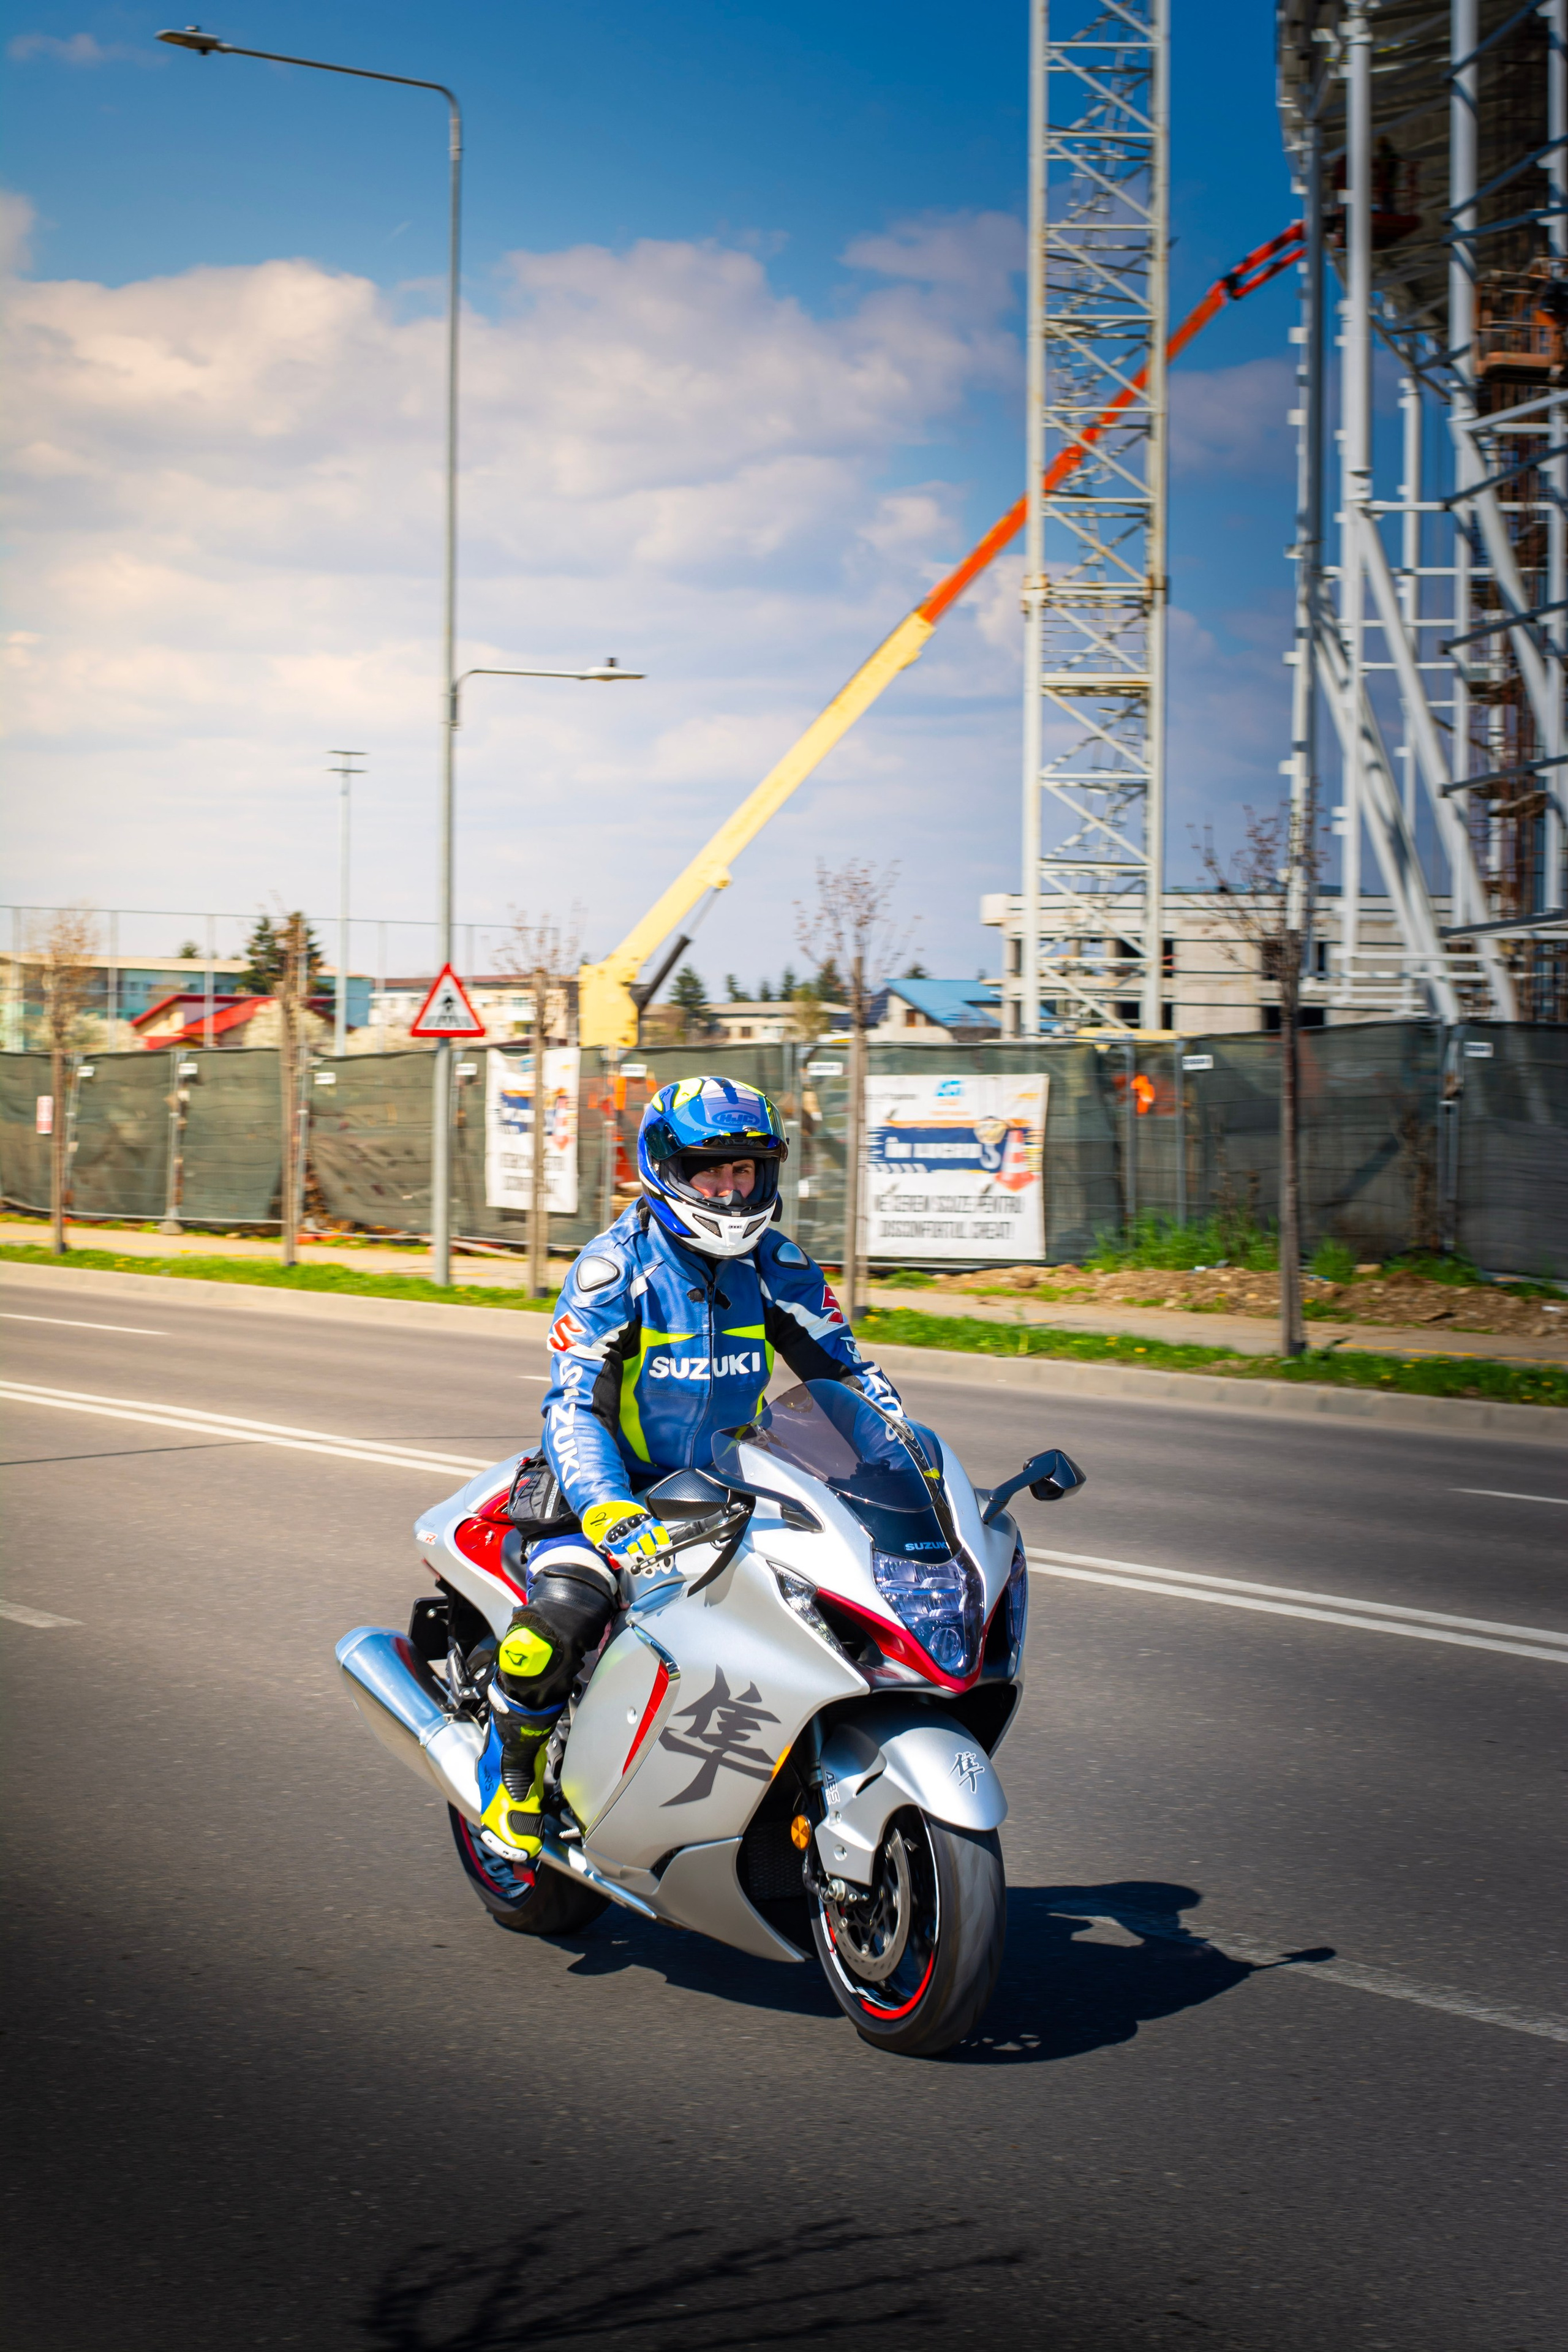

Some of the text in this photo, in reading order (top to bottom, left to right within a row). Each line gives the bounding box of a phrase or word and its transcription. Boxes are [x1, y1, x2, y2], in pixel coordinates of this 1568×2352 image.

[719, 1114, 754, 1123] HJC
[649, 1352, 761, 1380] SUZUKI
[905, 1542, 948, 1551] SUZUK
[824, 1770, 841, 1804] ABS
